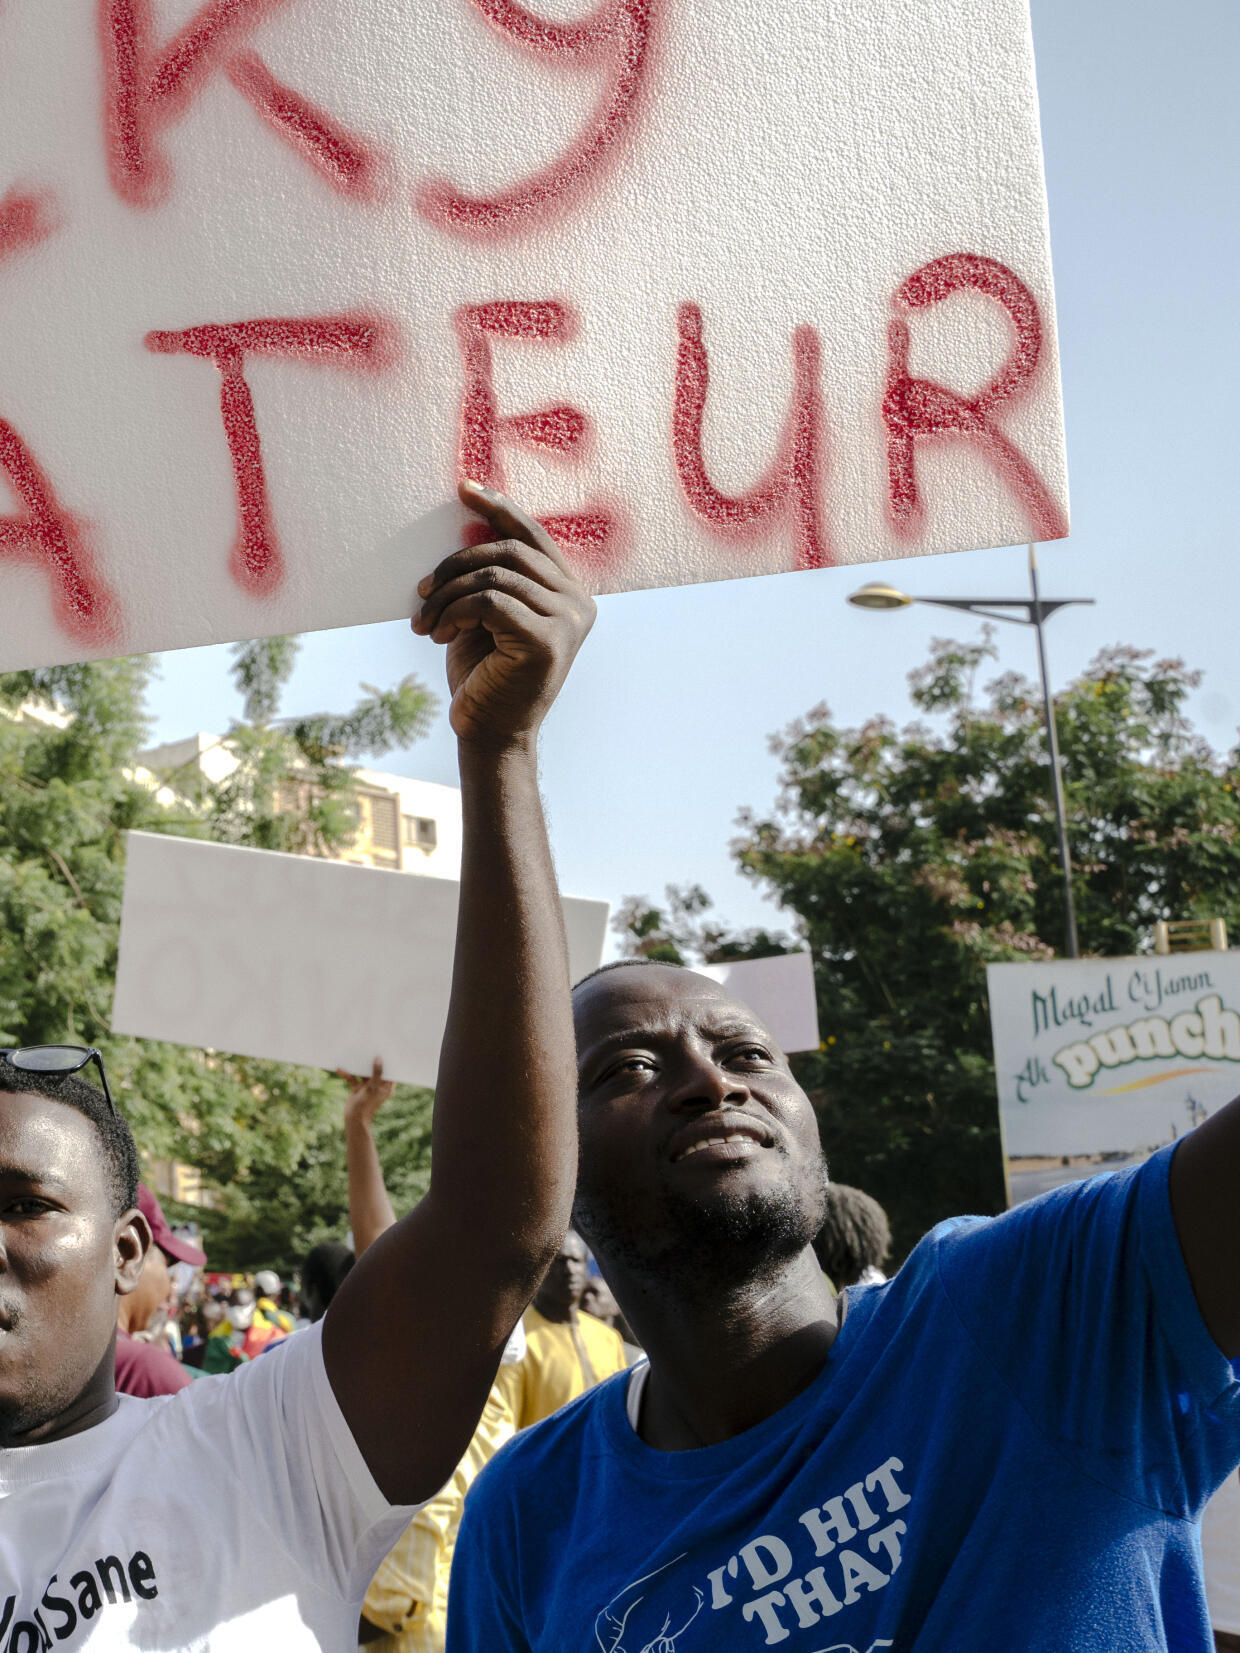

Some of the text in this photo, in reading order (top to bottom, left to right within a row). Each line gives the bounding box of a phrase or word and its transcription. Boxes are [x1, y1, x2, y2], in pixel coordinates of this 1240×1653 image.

[1052, 993, 1240, 1090] punch
[707, 1456, 912, 1611] I'D HIT
[742, 1519, 907, 1646] THAT
